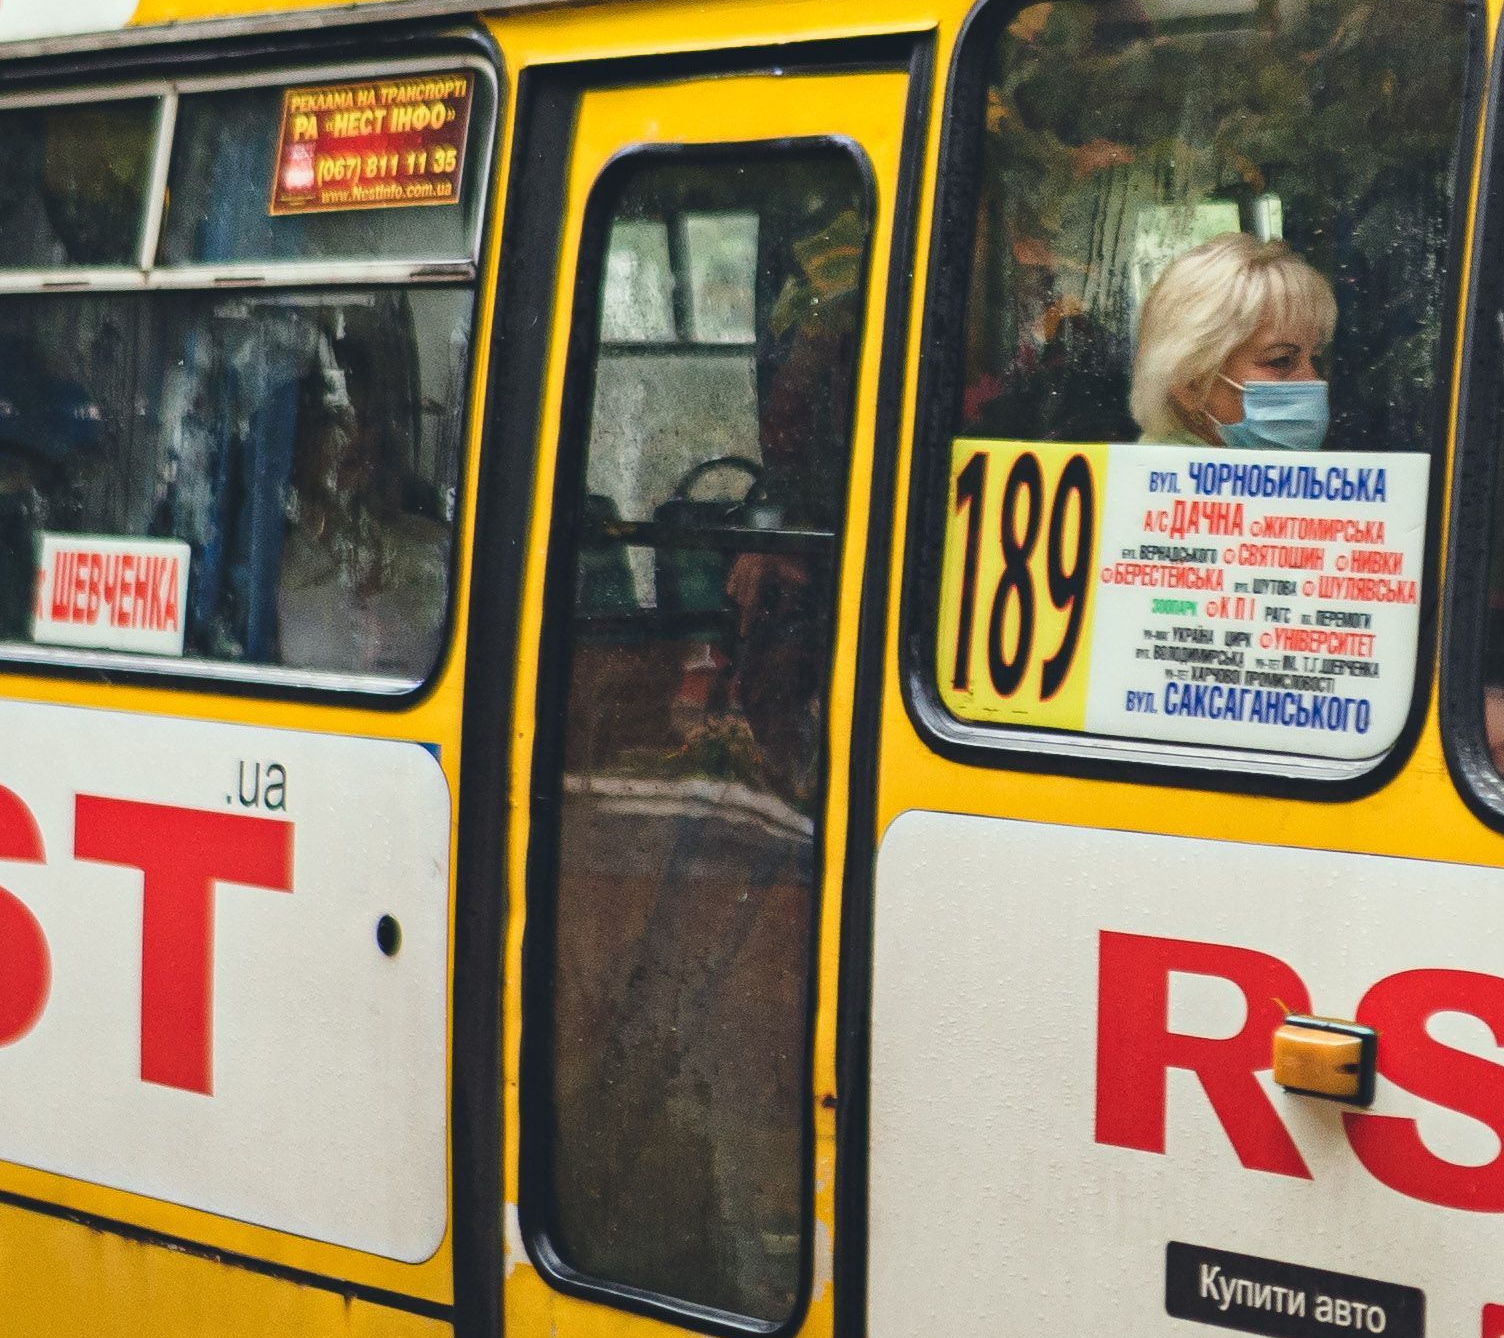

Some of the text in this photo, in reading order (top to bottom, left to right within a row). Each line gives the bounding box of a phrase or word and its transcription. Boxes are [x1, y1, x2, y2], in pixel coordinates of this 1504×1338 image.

[291, 79, 467, 111] РЕКЛАМА НА ТРАНСПОРТІ
[293, 112, 318, 140] РА
[317, 146, 457, 187] (067) 811 11 35
[1148, 461, 1388, 503] ВУЛ. ЧОРНОБИЛЬСЬКА
[1169, 499, 1245, 540] ДАЧНА
[1262, 515, 1386, 544] ЖИТОМИРСЬКА
[952, 451, 1095, 702] 189
[1237, 543, 1326, 571] СВЯТОШИН
[1350, 549, 1405, 576] НИВКИ
[52, 551, 178, 632] ШЕВЧЕНКА
[1318, 575, 1418, 604] ШУЛЯВСЬКА
[1274, 628, 1376, 657] УНІВЕРСИТЕТ
[1125, 681, 1371, 734] ВУЛ. САКСАГАНСЬКОГО
[226, 759, 288, 811] .ua
[1199, 1264, 1387, 1334] Купити авто
